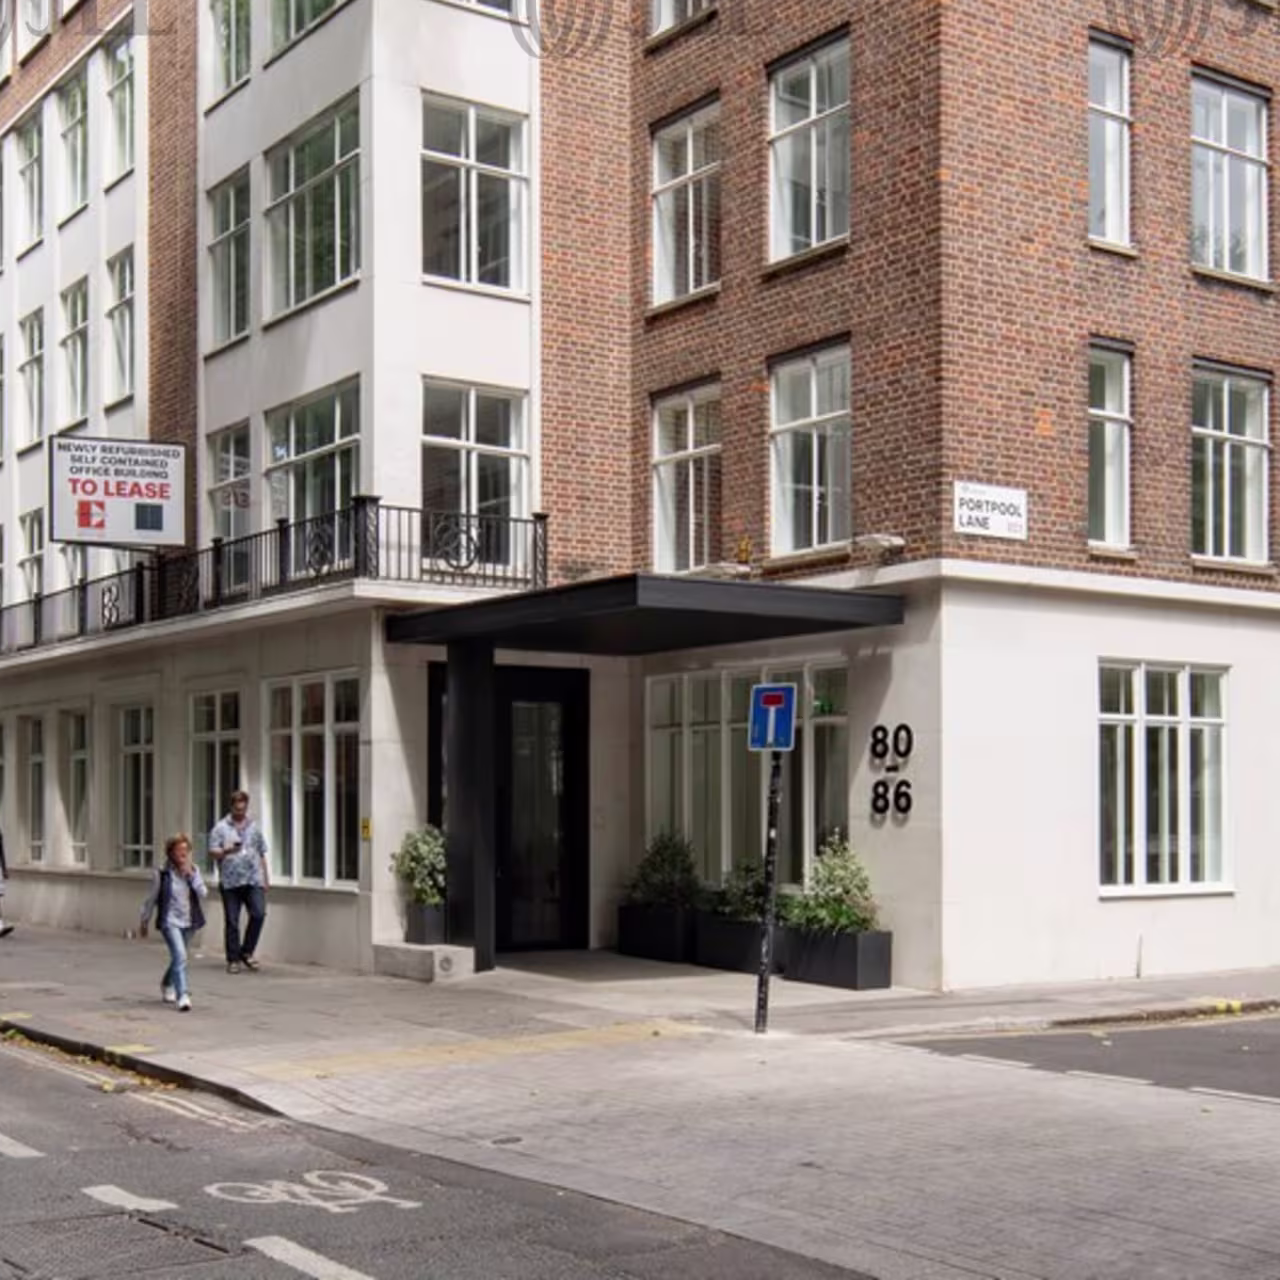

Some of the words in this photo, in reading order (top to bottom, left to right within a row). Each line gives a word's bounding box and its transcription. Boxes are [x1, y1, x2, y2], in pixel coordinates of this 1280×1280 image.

[58, 442, 98, 453] NEWLY
[101, 445, 180, 459] REFURBISHED
[70, 455, 97, 464] SELF
[100, 456, 168, 468] CONTAINED
[69, 466, 111, 476] OFFICE
[114, 468, 168, 479] BUILDING
[68, 478, 98, 496] TO
[104, 480, 171, 499] LEASE
[959, 497, 1022, 518] PORTPOOL
[959, 515, 990, 530] LANE
[871, 724, 912, 758] 80
[872, 780, 911, 814] 86
